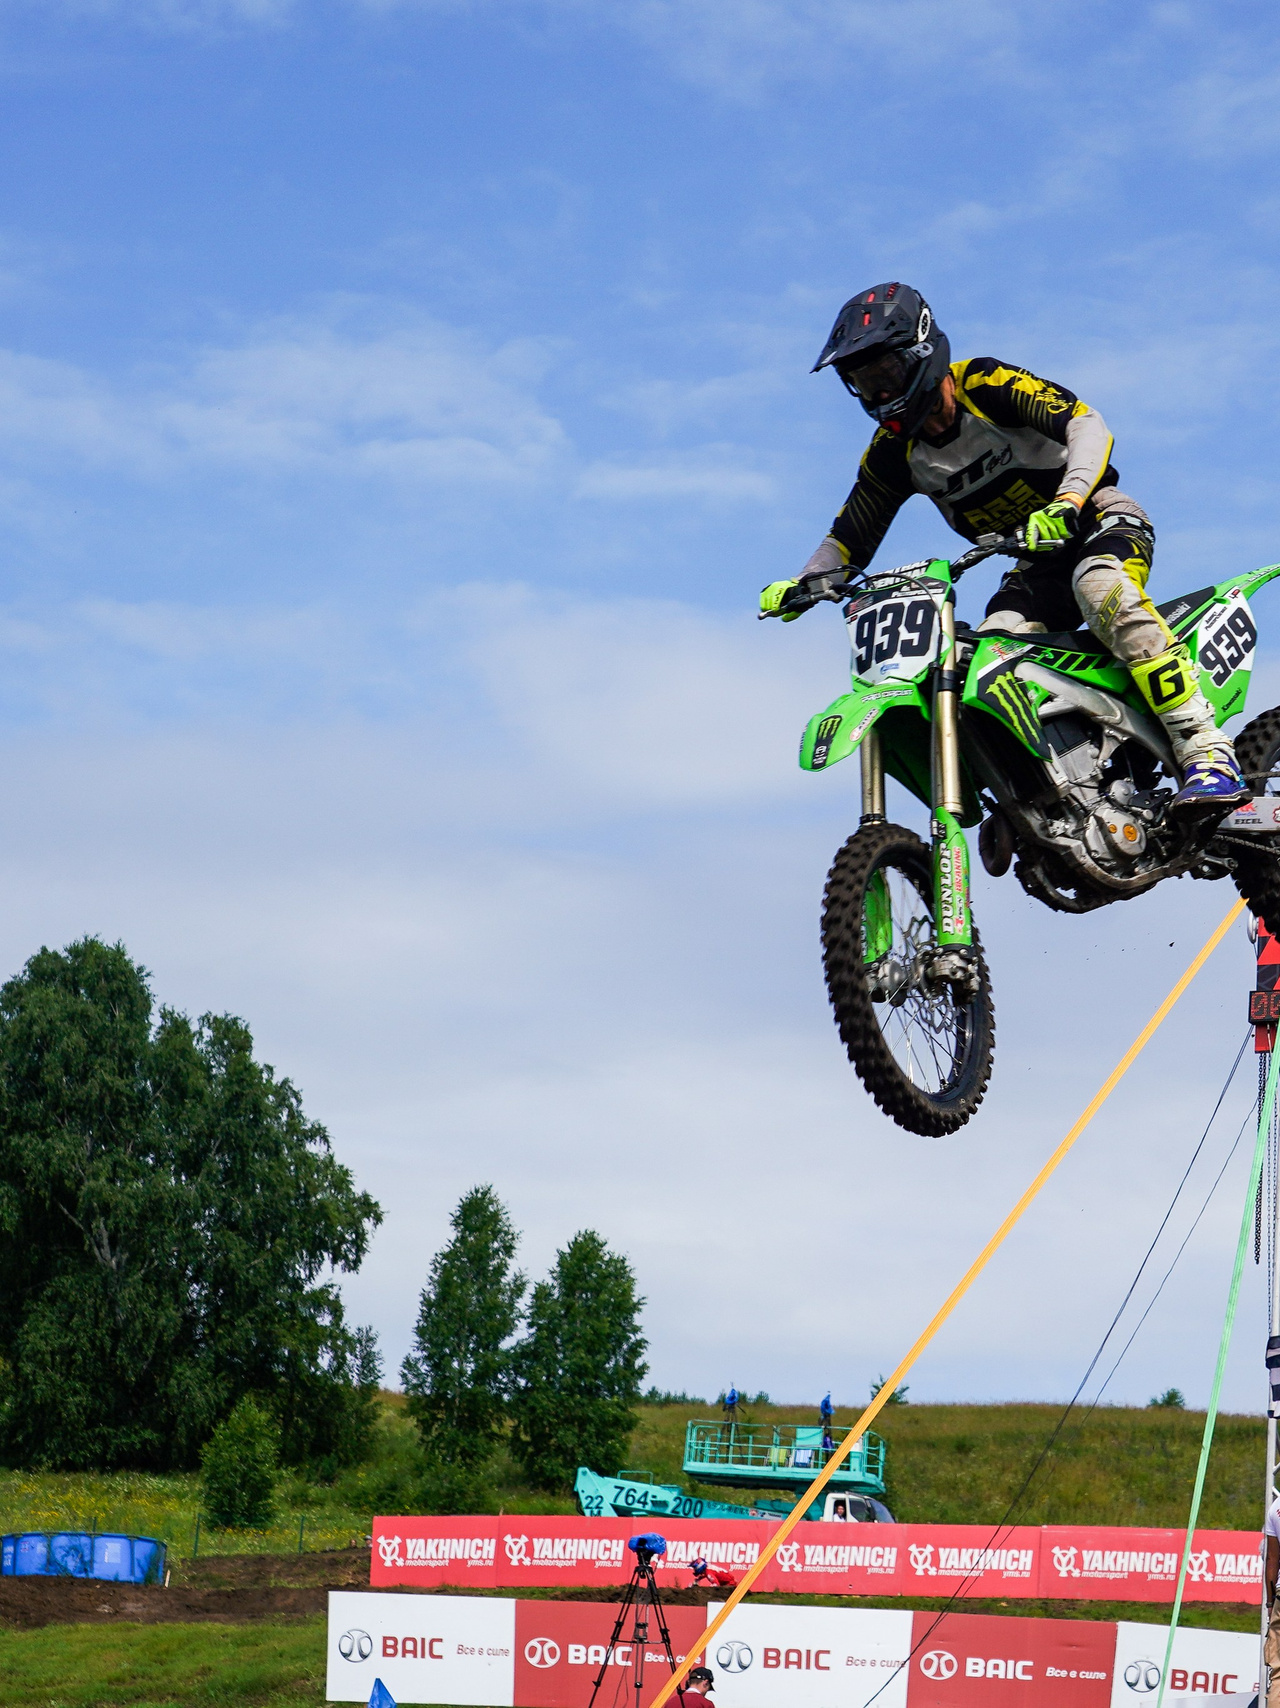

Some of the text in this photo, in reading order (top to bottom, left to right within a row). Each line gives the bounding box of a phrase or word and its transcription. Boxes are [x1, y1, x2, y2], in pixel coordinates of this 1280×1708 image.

[855, 600, 936, 676] 939
[1198, 606, 1258, 688] 939
[938, 842, 955, 935] DUNLOP
[405, 1538, 496, 1560] YAKHNICH
[532, 1538, 625, 1561] YAKHNICH
[666, 1541, 760, 1564] YAKHNICH
[803, 1544, 897, 1567] YAKHNICH
[938, 1548, 1033, 1571] YAKHNICH
[1081, 1550, 1178, 1574] YAKHNICH
[1214, 1553, 1264, 1576] YAKH
[381, 1635, 444, 1660] BAIC
[567, 1644, 633, 1667] BAIC
[763, 1647, 831, 1671] BAIC
[965, 1657, 1034, 1681] BAIC
[1170, 1669, 1238, 1695] BAIC
